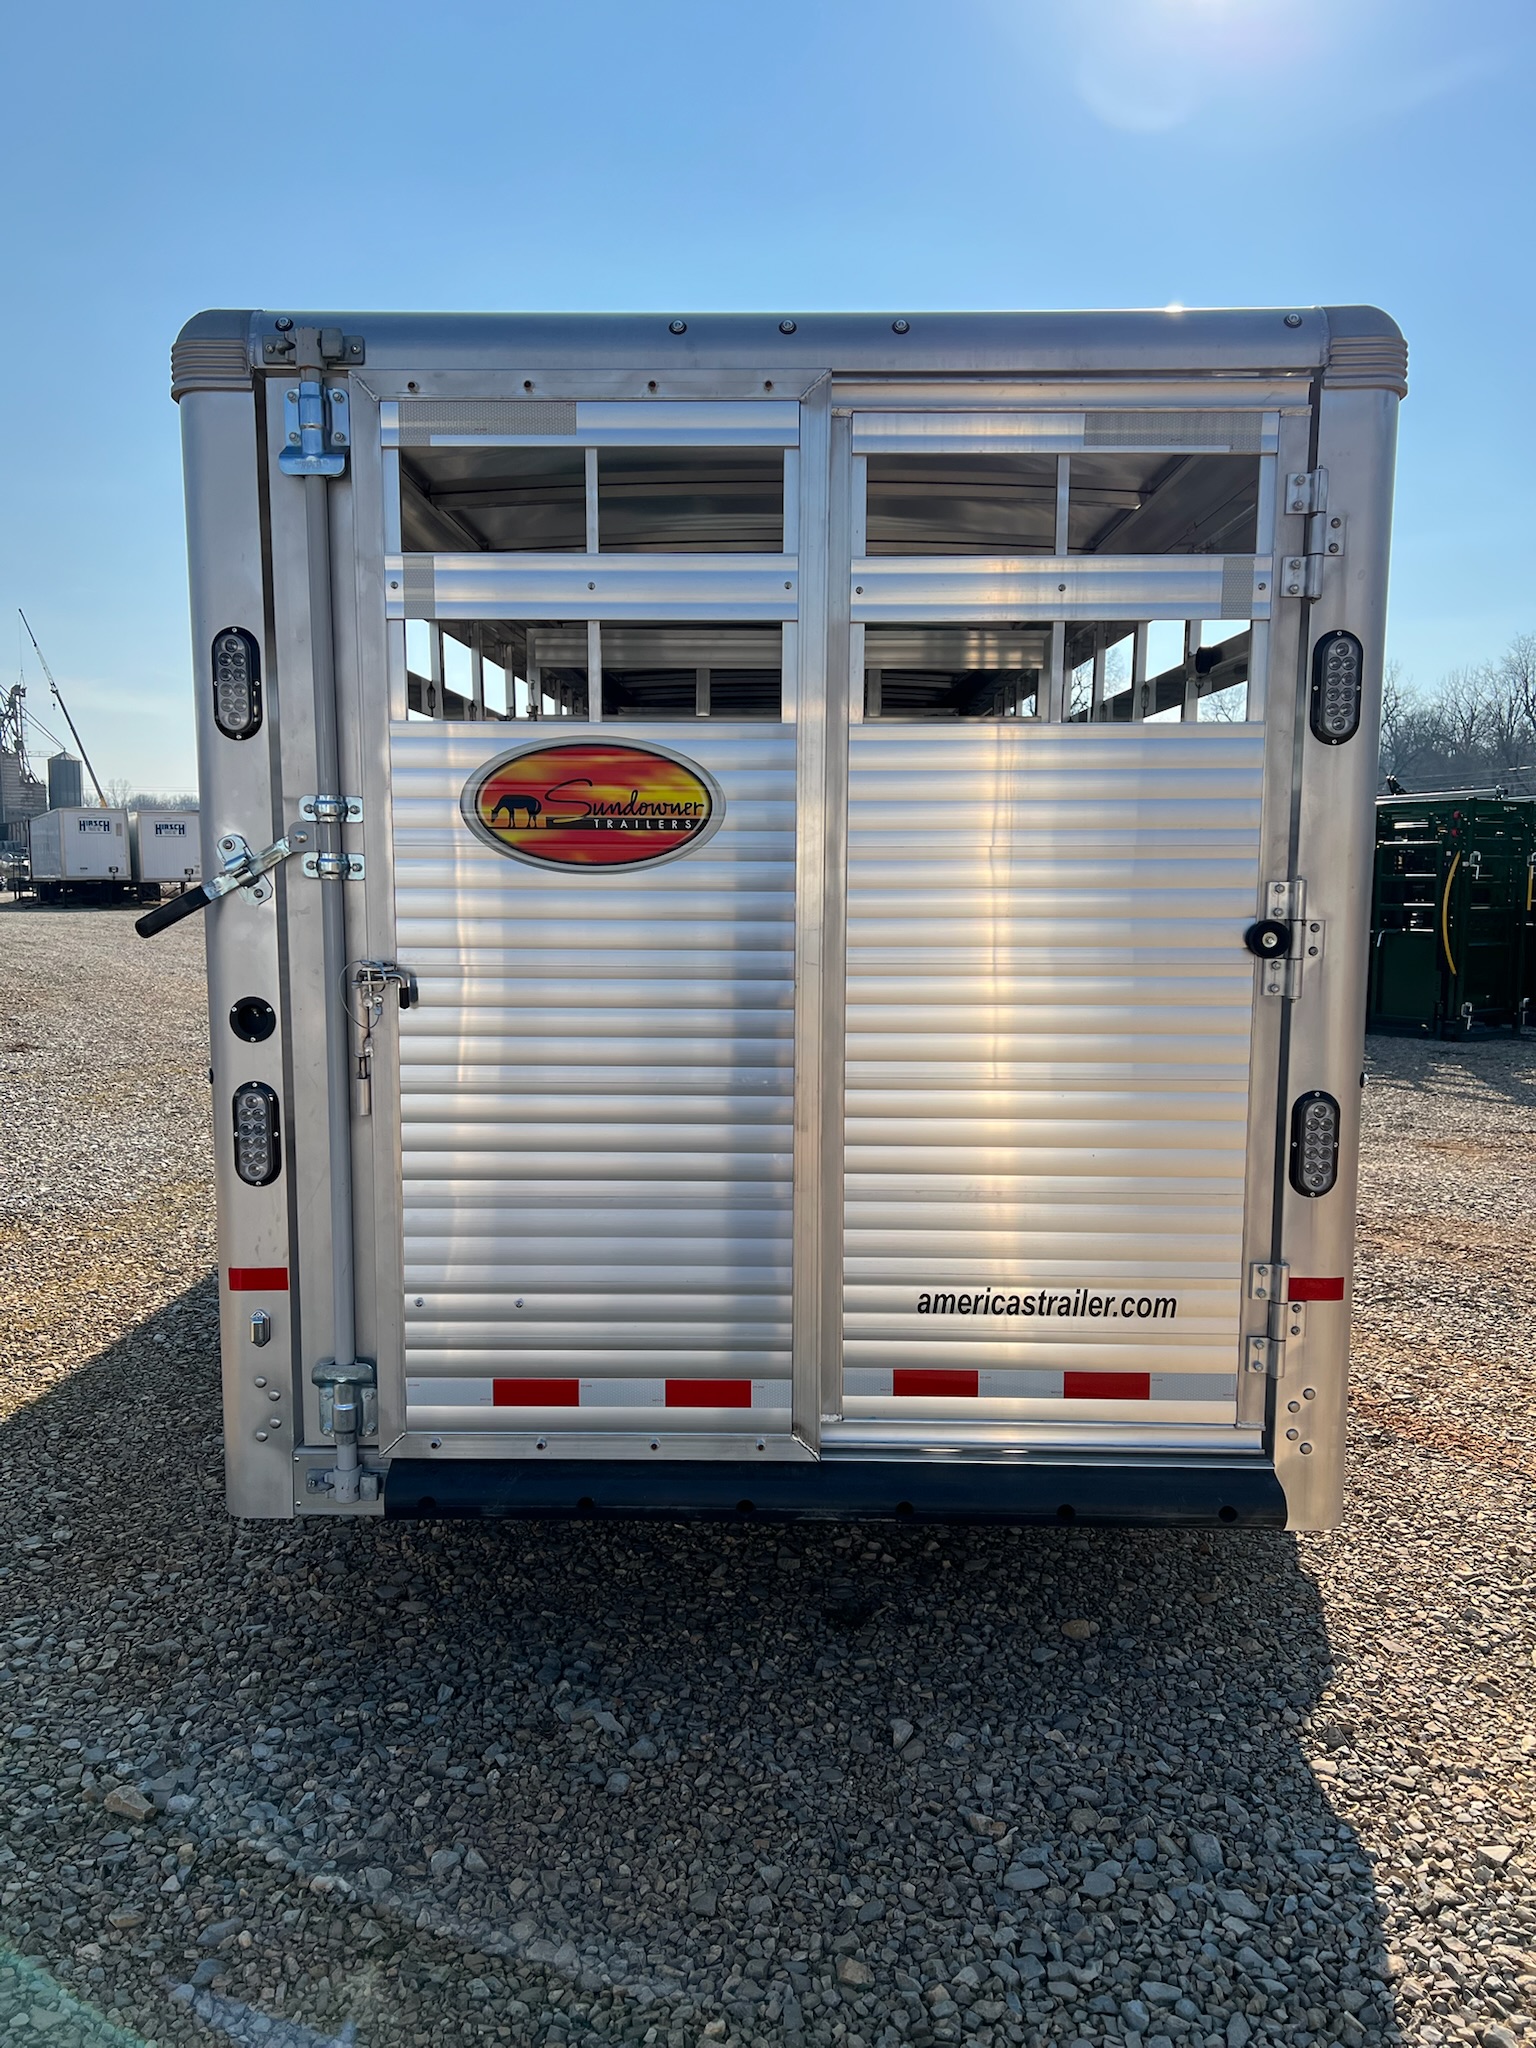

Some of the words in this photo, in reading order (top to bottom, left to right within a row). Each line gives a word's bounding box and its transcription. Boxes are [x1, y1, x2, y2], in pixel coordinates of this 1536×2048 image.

[544, 778, 705, 822] Sundowner
[79, 820, 110, 832] HIRSCH
[155, 823, 185, 835] HIRSCH
[593, 818, 692, 829] TRAILERS
[917, 1286, 1177, 1318] americastrailer.com
